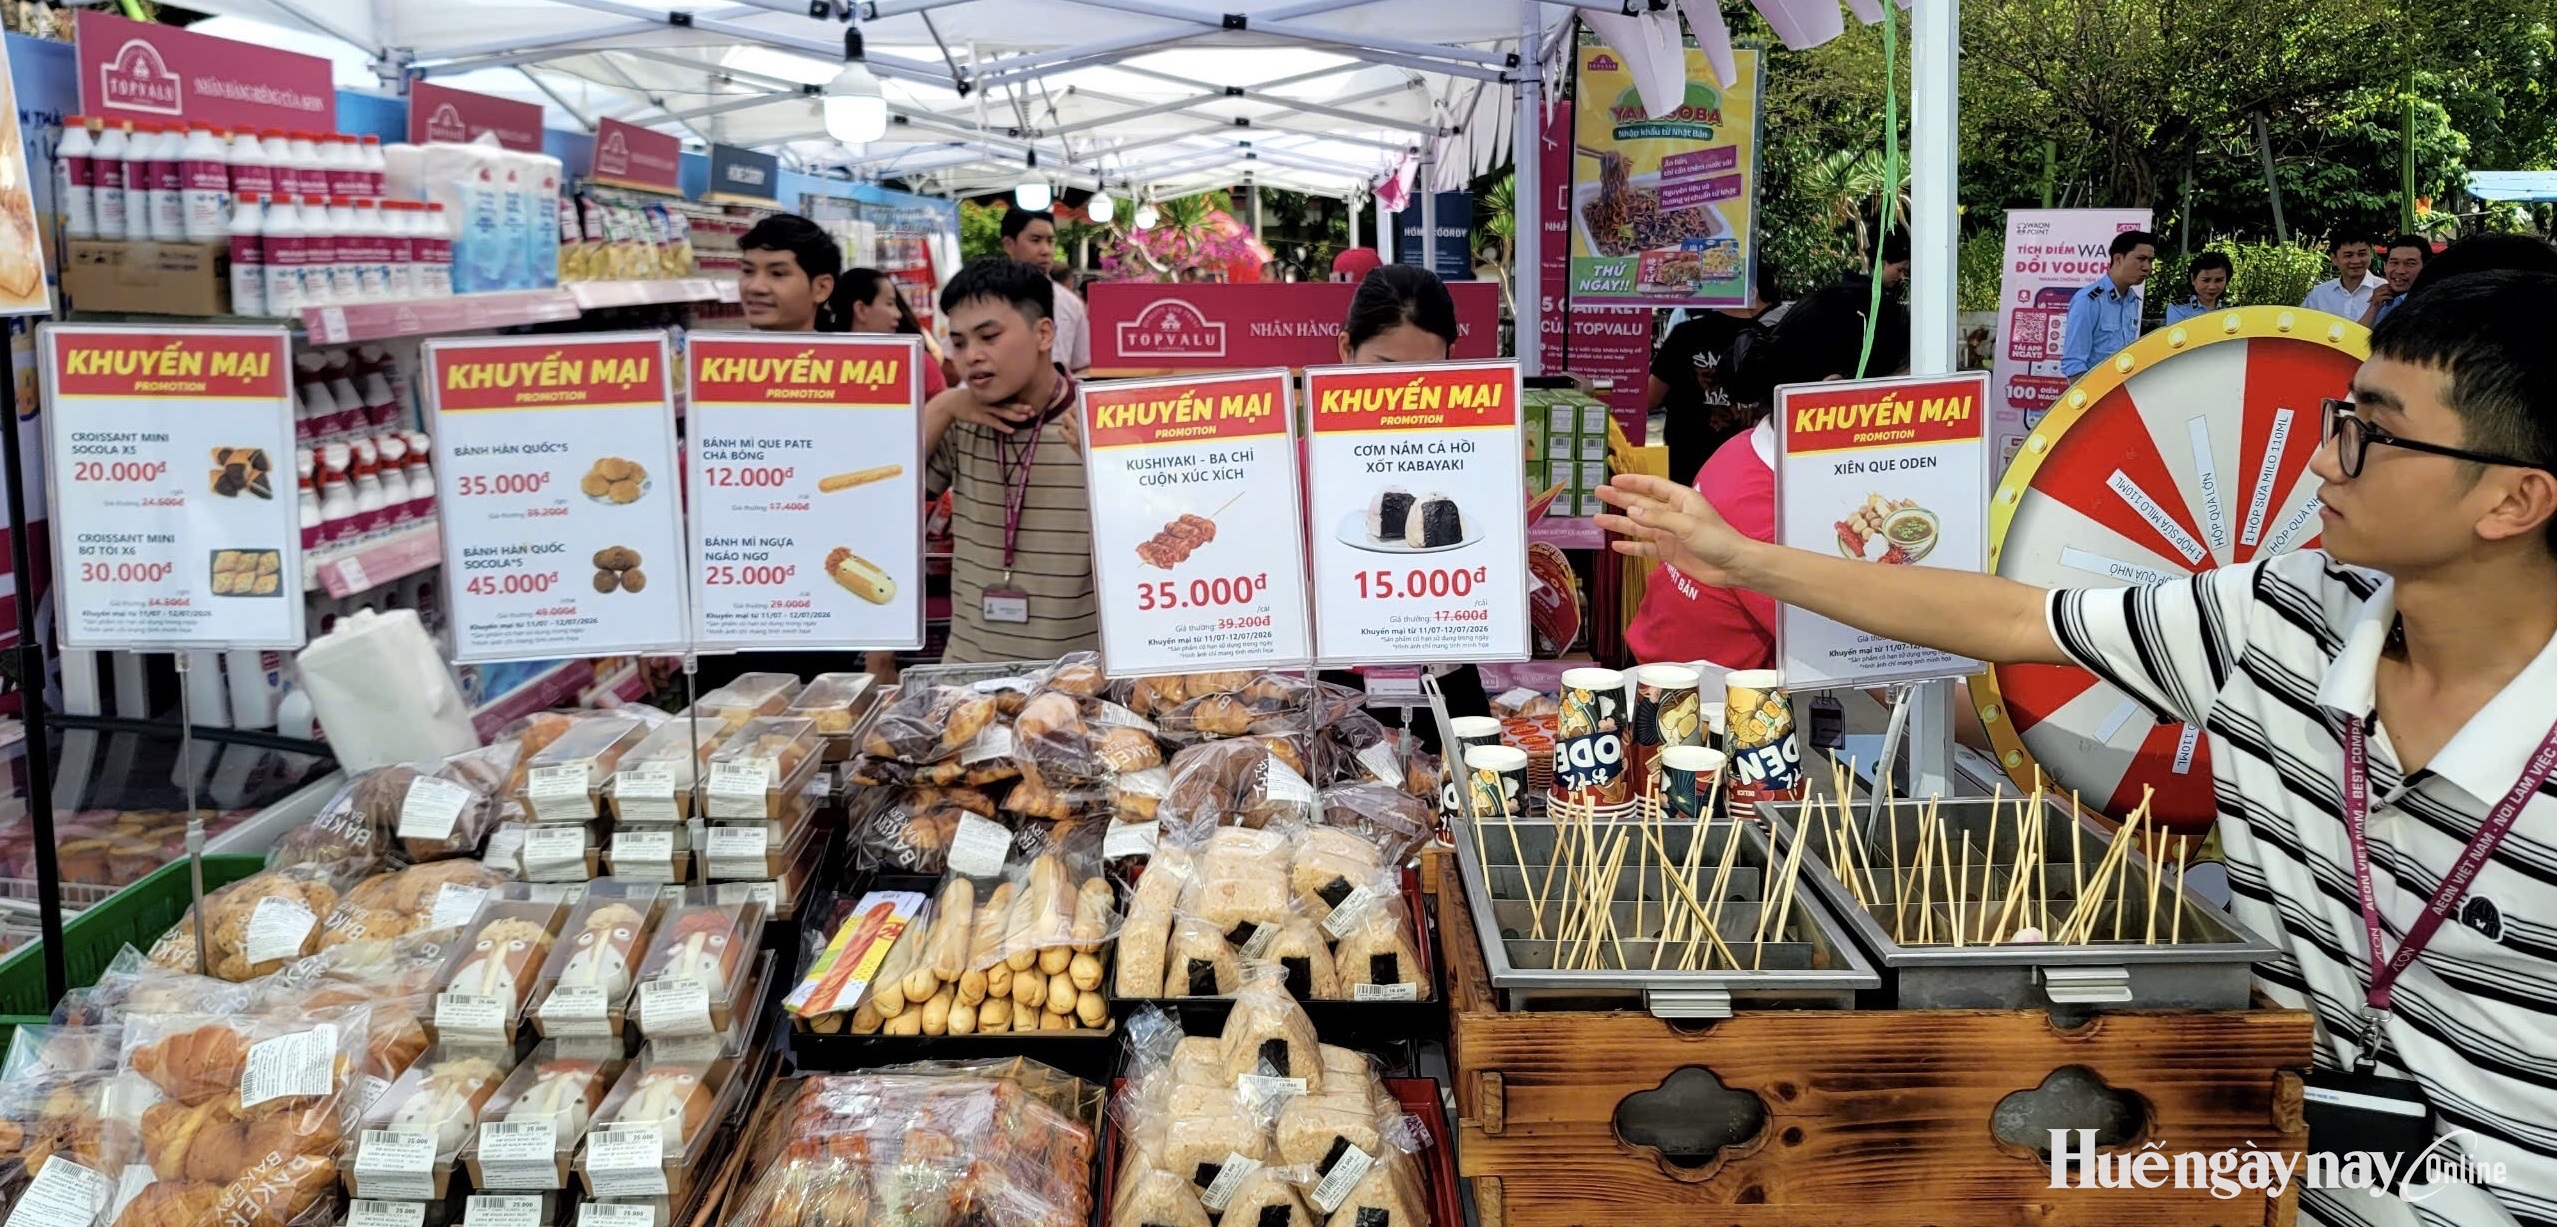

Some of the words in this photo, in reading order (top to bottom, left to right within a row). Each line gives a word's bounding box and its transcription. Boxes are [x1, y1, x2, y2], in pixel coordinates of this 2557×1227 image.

[109, 77, 175, 101] TOPVALU
[2078, 244, 2107, 258] WA
[1594, 260, 1628, 278] THỬ
[2016, 255, 2046, 273] ĐỔI
[2052, 261, 2111, 274] VOUCH
[1579, 278, 1630, 292] NGAY!!
[1541, 296, 1553, 313] 5
[1250, 320, 1293, 337] NHÃN
[1297, 319, 1340, 337] HÀNG
[1574, 322, 1643, 336] TOPVALU
[1127, 333, 1216, 347] TOPVALU
[67, 340, 205, 377] KHUYẾN
[210, 351, 271, 384] MẠI
[447, 351, 584, 390] KHUYẾN
[591, 357, 650, 390] MẠI
[700, 349, 833, 385] KHUYẾN
[839, 359, 898, 391] MẠI
[134, 380, 207, 393] PROMOTION
[766, 388, 835, 400] PROMOTION
[1321, 377, 1440, 414] KHUYẾN
[1448, 383, 1503, 414] MẠI
[2006, 385, 2036, 400] 100
[515, 390, 587, 403] PROMOTION
[1095, 388, 1212, 429] KHUYẾN
[1220, 392, 1272, 424] MẠI
[1795, 392, 1914, 433] KHUYẾN
[1919, 395, 1972, 427] MẠI
[1380, 414, 1444, 426] PROMOTION
[71, 432, 138, 442] CROISSANT
[141, 433, 170, 443] MINI
[1155, 425, 1217, 439] PROMOTION
[1853, 429, 1915, 443] PROMOTION
[72, 445, 119, 455] SOCOLA
[454, 445, 489, 457] BÁNH
[493, 443, 519, 455] HÀN
[703, 436, 737, 448] BÁNH
[740, 437, 755, 448] MÌ
[757, 439, 782, 450] QUE
[785, 439, 813, 449] PATE
[1354, 444, 1386, 457] CƠM
[1390, 440, 1424, 456] NẮM
[1427, 439, 1446, 454] CÁ
[1450, 438, 1475, 453] HỒI
[1126, 454, 1196, 471] KUSHIYAKI
[1209, 452, 1228, 466] BA
[1366, 457, 1392, 473] XỐT
[1398, 459, 1464, 473] KABAYAKI
[1834, 459, 1864, 475] XIÊN
[1869, 458, 1896, 473] QUE
[1900, 456, 1937, 470] ODEN
[74, 461, 167, 482] 20.000đ
[705, 466, 794, 487] 12.000đ
[1139, 470, 1178, 488] CUỘN
[1181, 467, 1209, 484] XÚC
[1213, 466, 1245, 482] XÍCH
[2247, 509, 2260, 532] HỘP
[2262, 454, 2278, 483] MILO
[2271, 416, 2289, 451] 110ML
[458, 471, 551, 496] 35.000đ
[2115, 475, 2142, 505] 110ML
[2140, 501, 2165, 524] MILO
[77, 533, 144, 543] CROISSANT
[147, 534, 175, 544] MINI
[2211, 523, 2225, 547] HỘP
[2269, 529, 2289, 553] HỘP
[2289, 509, 2309, 532] QUÀ
[463, 545, 498, 558] BÁNH
[501, 544, 528, 556] HÀN
[531, 542, 566, 554] QUỐC
[705, 536, 738, 547] BÁNH
[742, 535, 756, 547] MÌ
[759, 537, 794, 549] NGỰA
[2176, 537, 2197, 556] HỘP
[705, 550, 740, 561] NGÁO
[742, 551, 770, 561] NGƠ
[80, 561, 172, 582] 30.000đ
[706, 564, 796, 585] 25.000đ
[466, 571, 559, 595] 45.000đ
[1137, 572, 1268, 611] 35.000đ
[1354, 566, 1487, 599] 15.000đ
[1677, 578, 1698, 601] BẢN
[1434, 609, 1488, 622] 17.600đ
[1361, 627, 1389, 636] Khuyến
[1391, 628, 1406, 636] mại
[1857, 635, 1869, 643] Giá
[1148, 637, 1176, 647] Khuyến
[1178, 636, 1192, 645] mại
[1829, 648, 1857, 658] Khuyến
[2177, 733, 2194, 767] 110ML
[2351, 717, 2364, 765] COMPA
[1553, 735, 1621, 774] ODE
[1736, 733, 1800, 786] DEN
[2352, 768, 2365, 799] BEST
[2353, 809, 2365, 841] NAM
[2432, 885, 2457, 916] AEON
[2470, 832, 2495, 862] NAM
[2528, 747, 2557, 775] VIỆC
[2360, 880, 2376, 911] AEON
[215, 1150, 282, 1220] BAKERY
